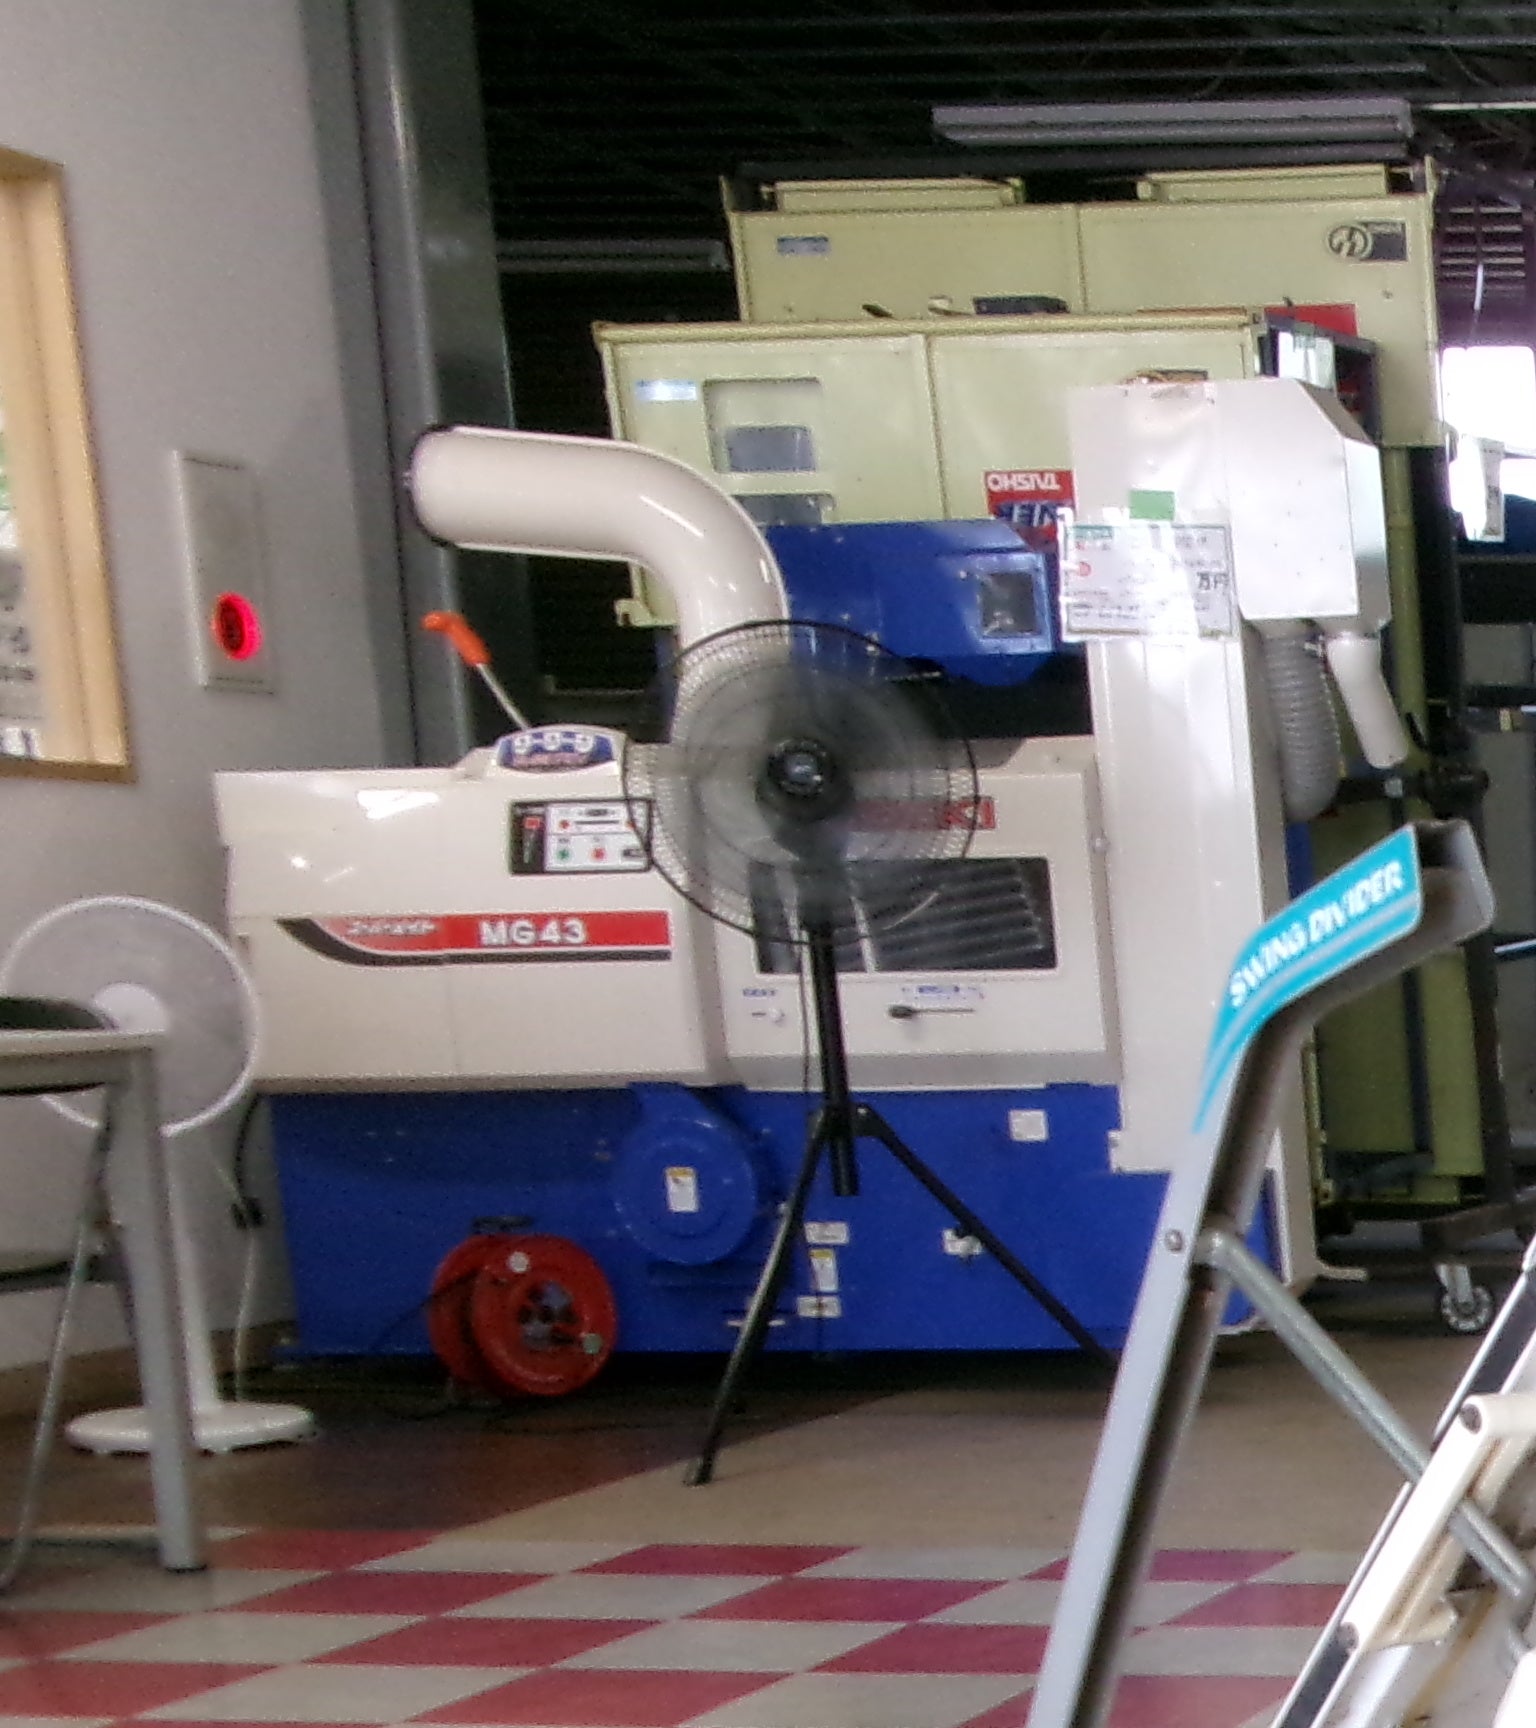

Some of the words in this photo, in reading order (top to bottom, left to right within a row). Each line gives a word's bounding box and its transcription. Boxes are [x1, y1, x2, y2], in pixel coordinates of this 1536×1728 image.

[480, 918, 587, 946] MG43
[1229, 921, 1308, 1008] SWING
[1307, 860, 1405, 943] DIVIDER
